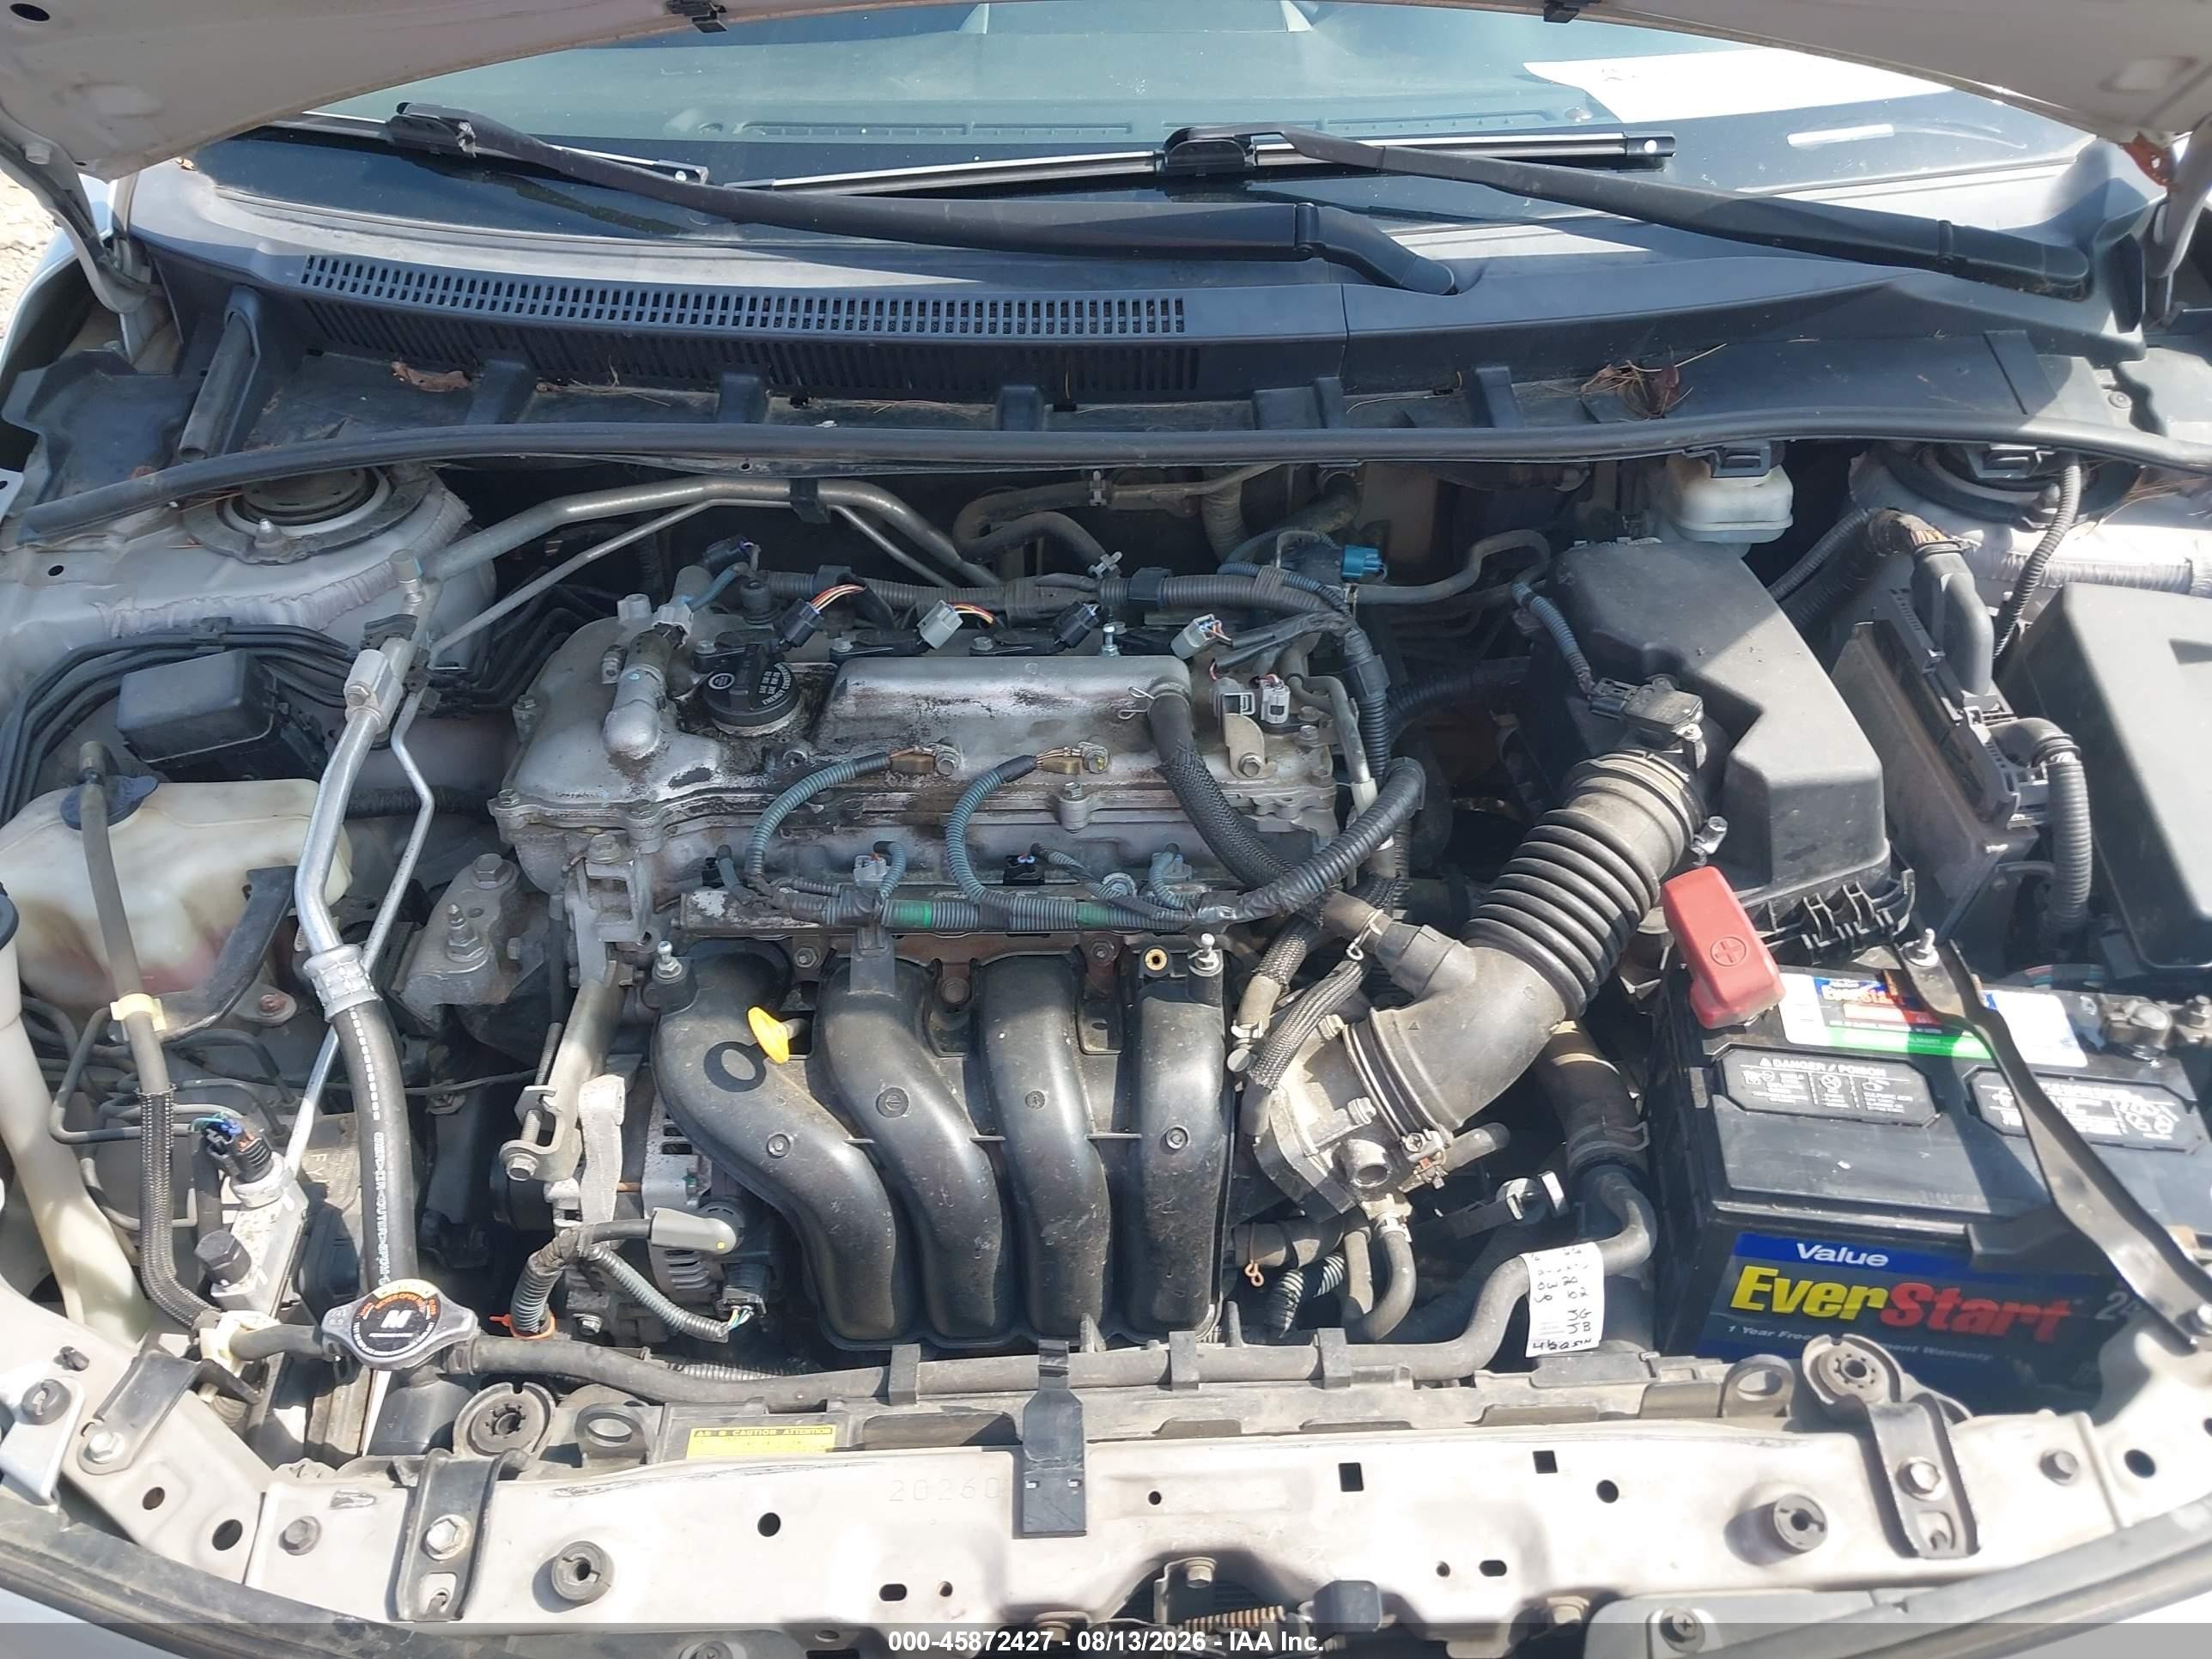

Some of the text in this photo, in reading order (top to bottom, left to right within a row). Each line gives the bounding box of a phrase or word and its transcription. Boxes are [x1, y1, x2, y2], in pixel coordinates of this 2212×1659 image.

[1772, 1058, 1826, 1072] DANGER
[1838, 1065, 1886, 1078] POISON
[1796, 1243, 1889, 1267] Value
[1730, 1265, 2073, 1344] EverStart
[1742, 1326, 1776, 1337] Year
[1778, 1330, 1813, 1341] Free
[732, 1428, 776, 1437] CAUTION
